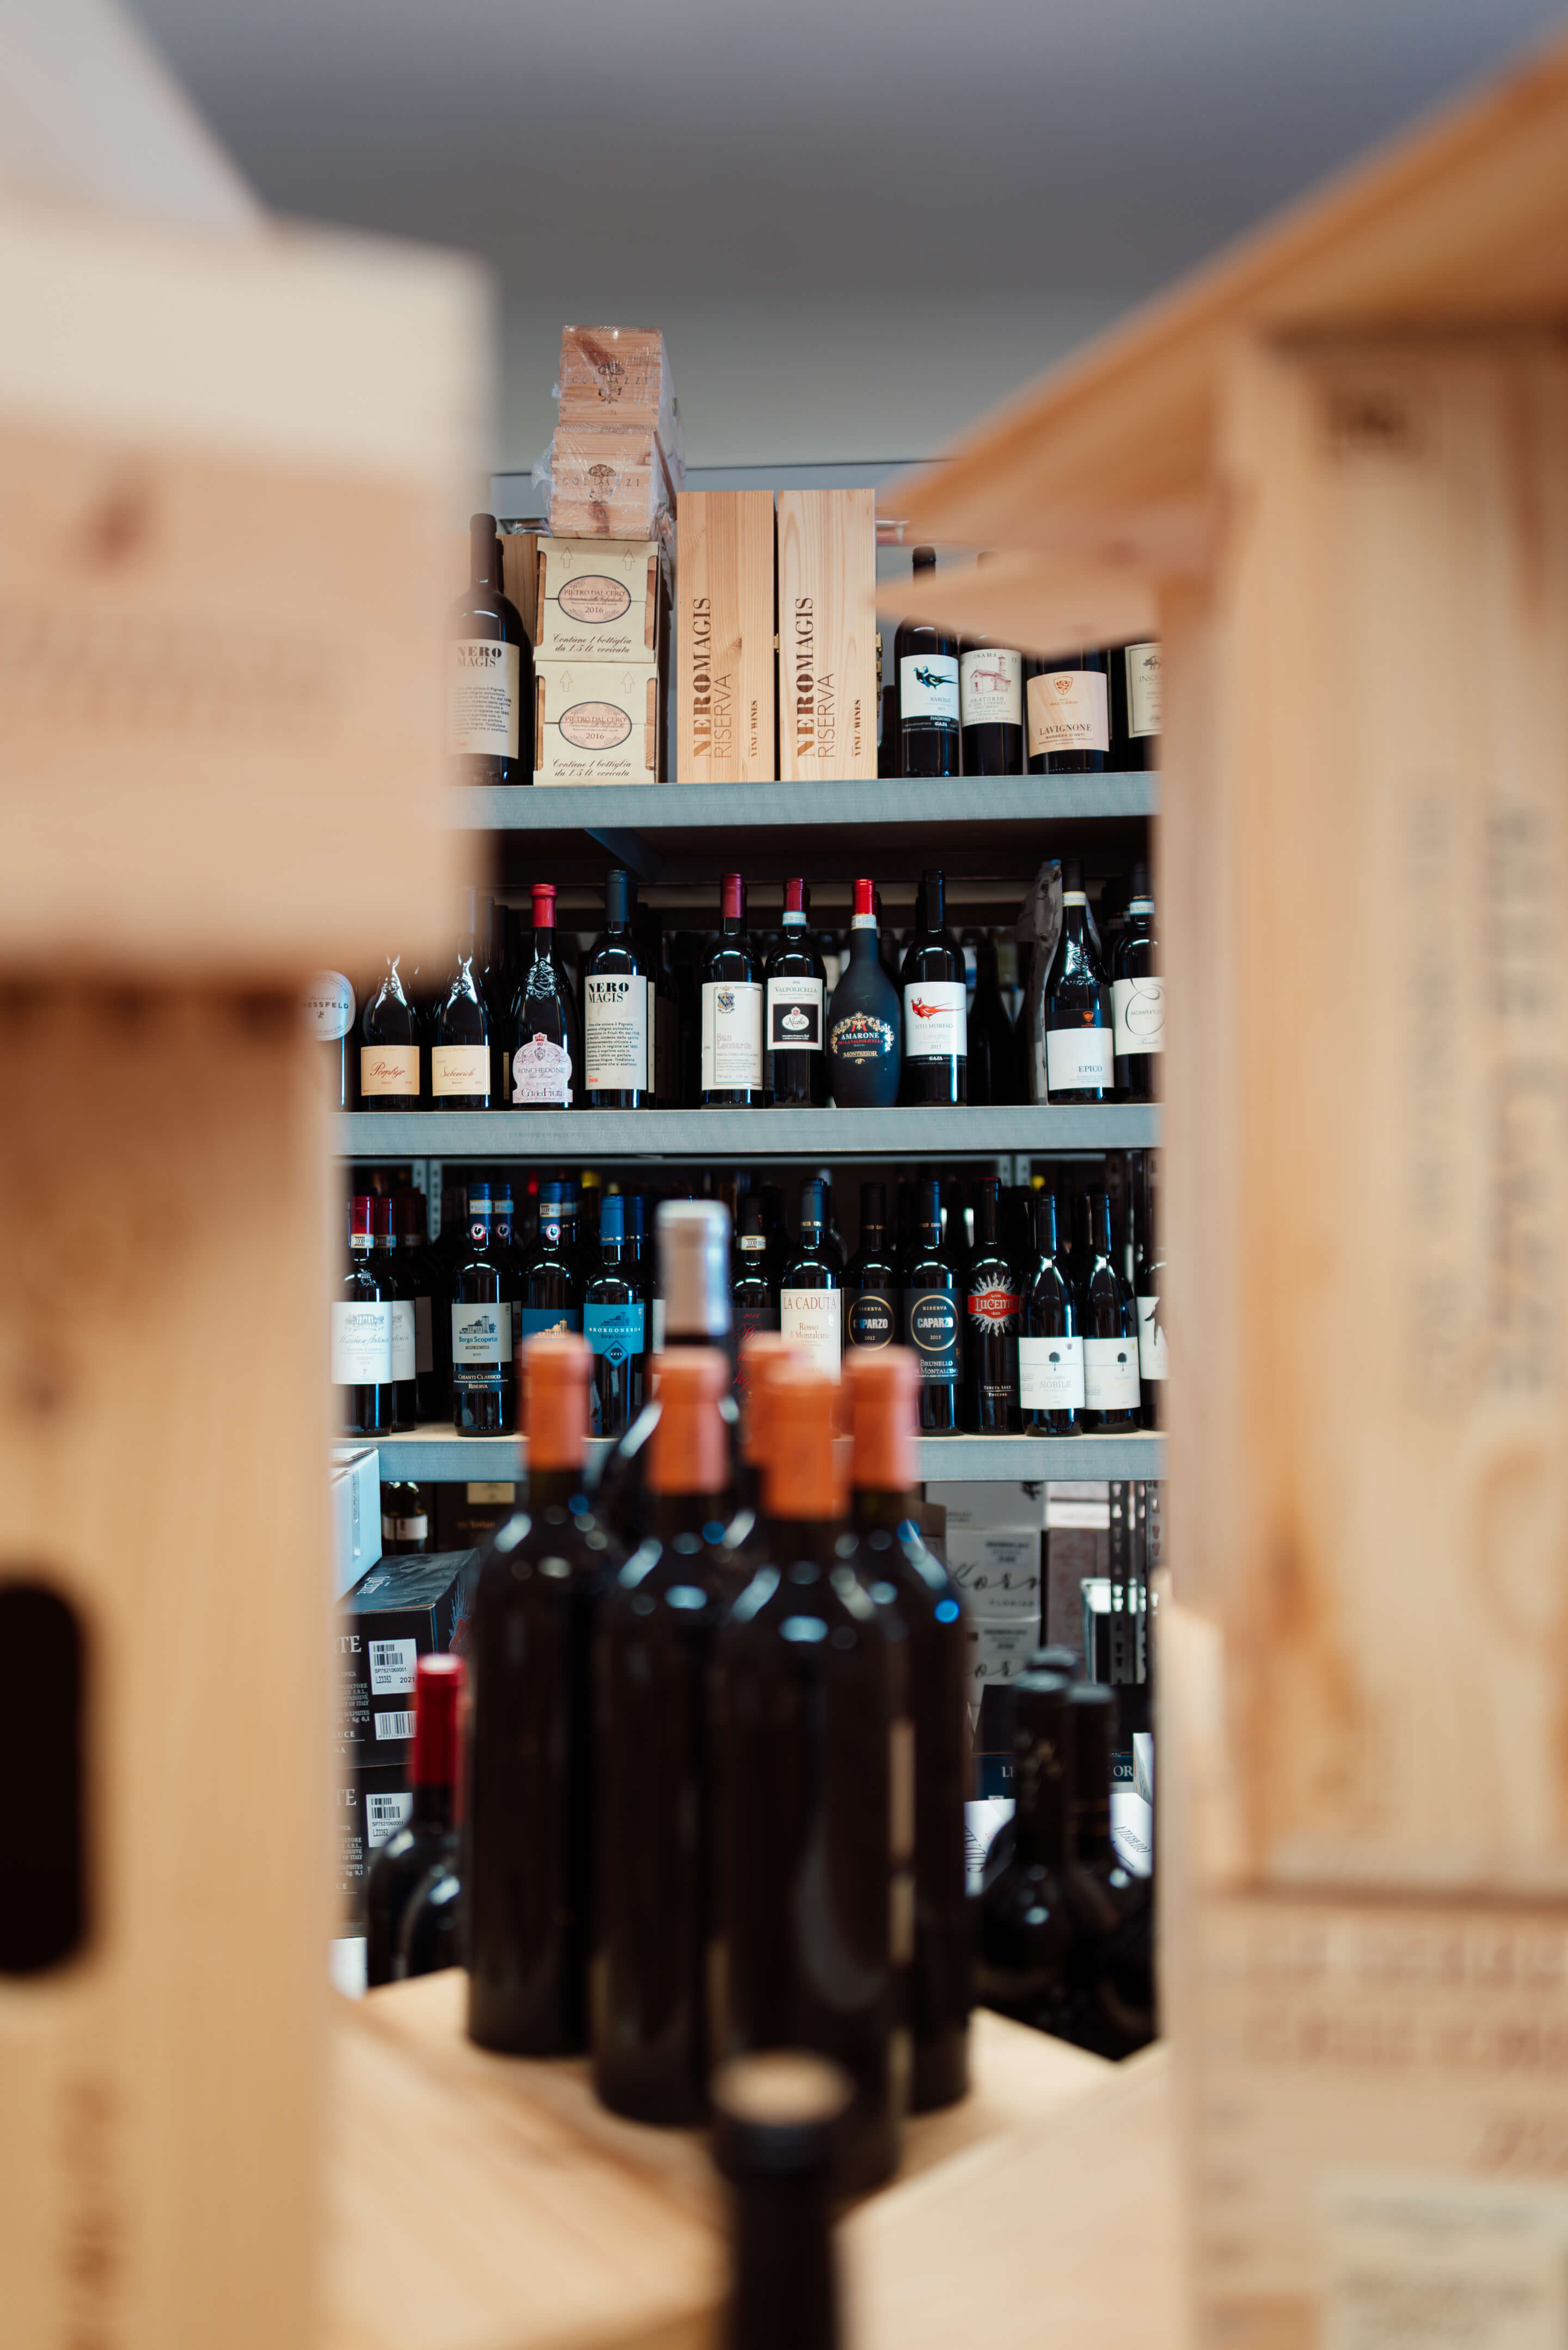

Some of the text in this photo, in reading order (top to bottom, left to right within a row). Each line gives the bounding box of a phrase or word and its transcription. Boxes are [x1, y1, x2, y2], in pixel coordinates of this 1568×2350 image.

[553, 633, 587, 643] Contiene
[597, 635, 632, 646] bottiglia
[457, 646, 502, 658] NERO
[457, 657, 497, 667] MAGIS
[693, 597, 712, 758] NEROMAGIS
[795, 597, 815, 758] NEROMAGIS
[714, 673, 733, 758] RISERVA
[817, 673, 836, 758] RISERVA
[1039, 724, 1093, 736] LAVIGNONE
[553, 758, 587, 768] Contiene
[596, 759, 632, 770] bottiglia
[554, 768, 566, 776] da
[588, 982, 630, 994] NERO
[588, 992, 623, 1004] MAGIS
[716, 1033, 732, 1042] San
[841, 1032, 880, 1041] AMARONE
[716, 1041, 752, 1050] Leonardo
[843, 1050, 878, 1058] MONTRESOR
[370, 1061, 406, 1079] Porphyr
[518, 1067, 566, 1075] RONCHEDONE
[783, 1296, 837, 1310] LA CADUTA
[975, 1298, 1016, 1312] LUCENTE
[799, 1322, 819, 1331] Rosso
[853, 1318, 889, 1329] CAPARZO
[917, 1316, 954, 1329] CAPARZO
[795, 1330, 830, 1339] Montalcino
[1040, 1380, 1072, 1389] NOBILE
[373, 1829, 389, 1837] L23352
